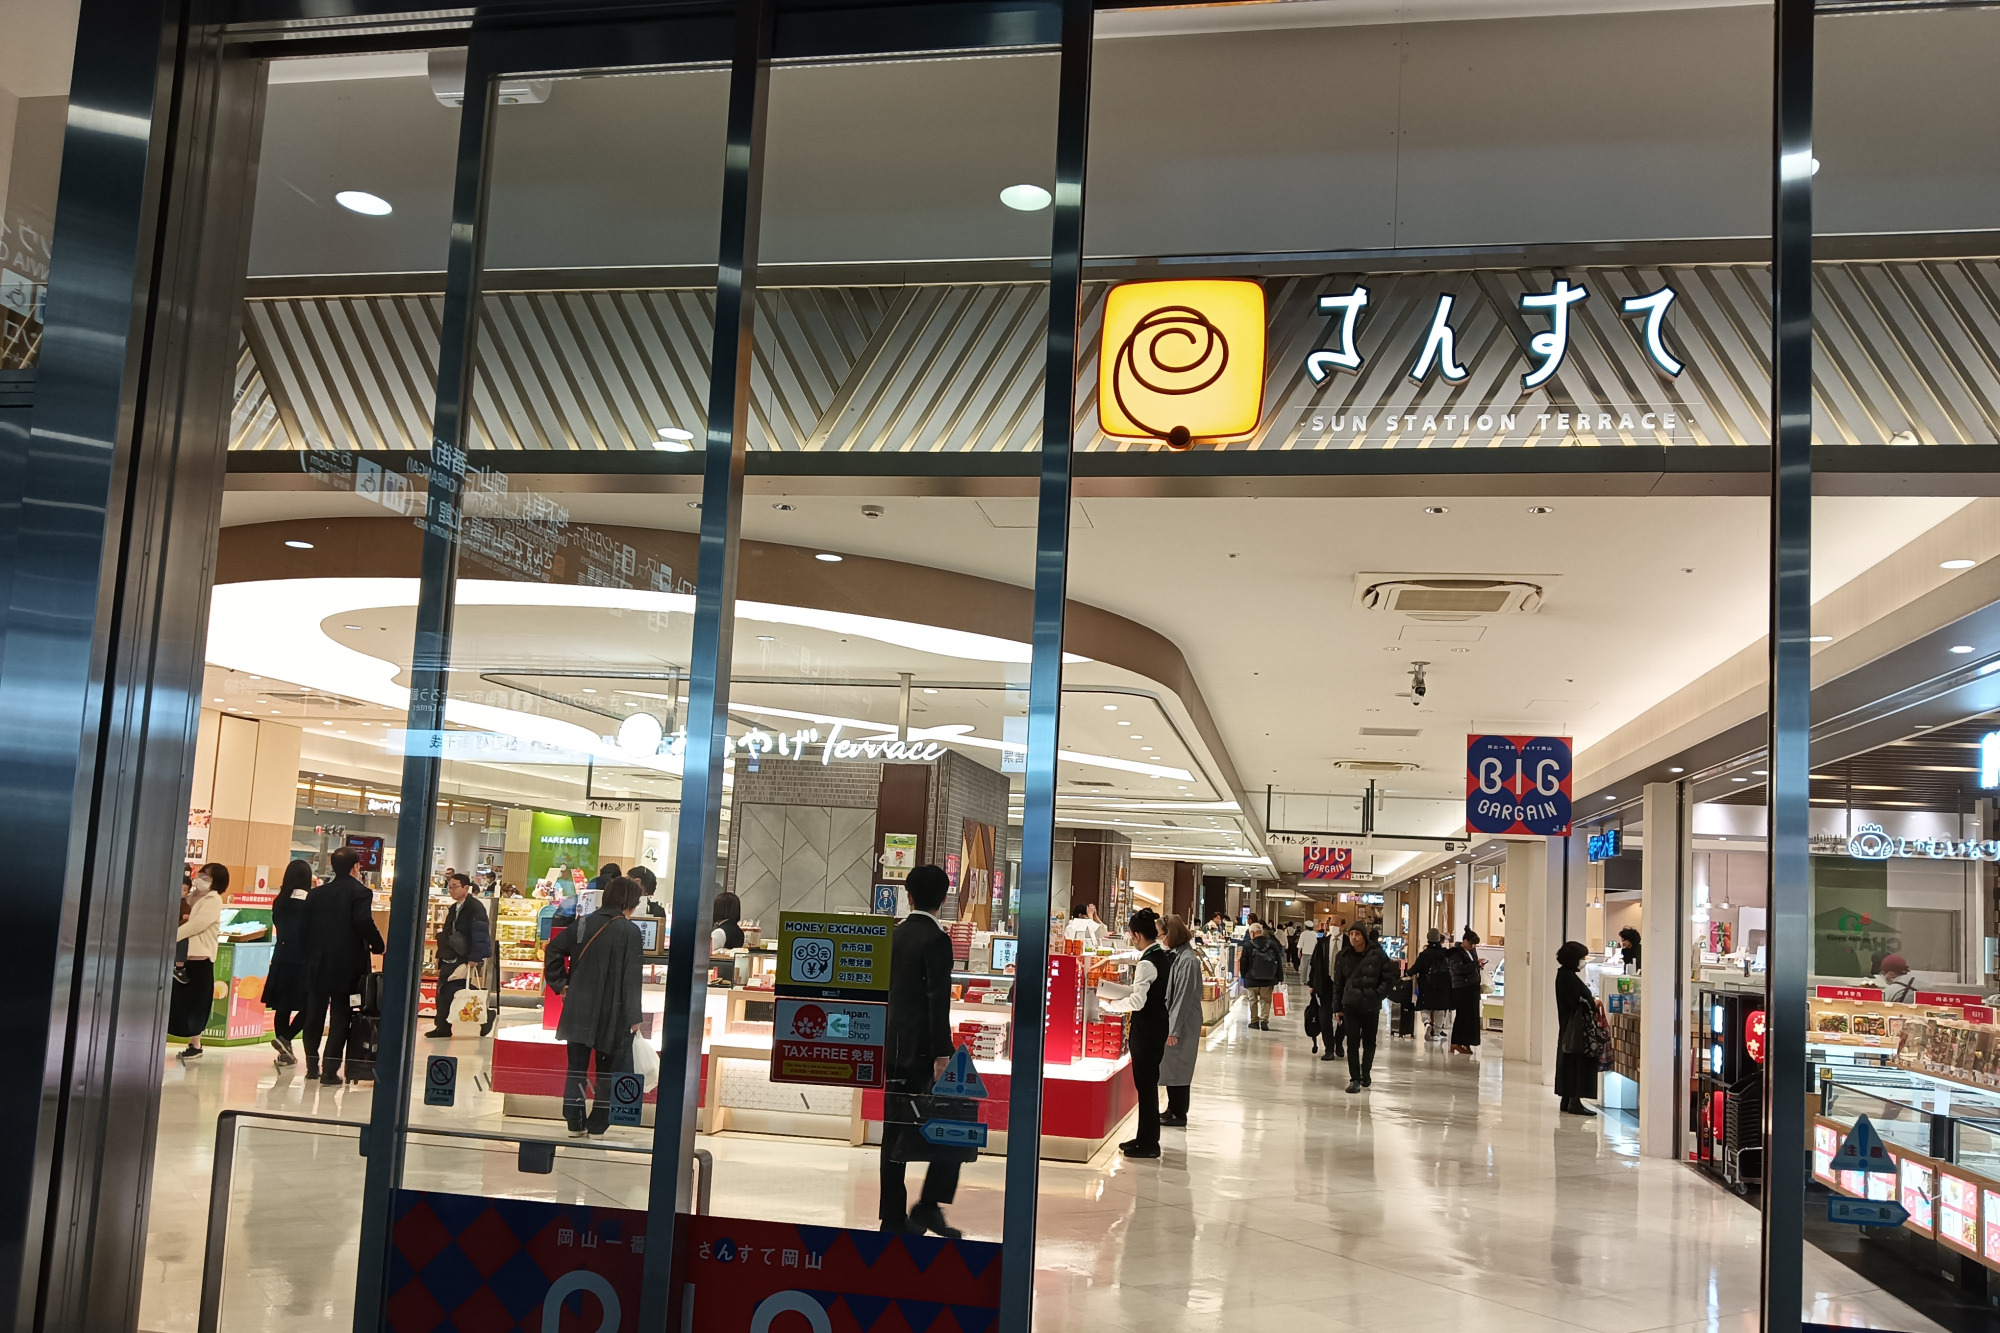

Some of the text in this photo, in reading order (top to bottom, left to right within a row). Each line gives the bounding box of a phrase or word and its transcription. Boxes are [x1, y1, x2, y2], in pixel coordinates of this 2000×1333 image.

[1305, 278, 1686, 394] さんすて
[1311, 412, 1677, 432] SUN STATION TERRACE
[815, 720, 948, 767] Terrace
[1479, 757, 1560, 797] BIG
[1478, 799, 1558, 821] BARGAIN
[541, 835, 589, 845] HAREMASU
[1308, 862, 1345, 874] BARGAIN
[784, 921, 887, 936] MONEY EXCHANGE
[837, 972, 872, 983] 외화환전
[848, 1030, 870, 1041] Shop
[782, 1045, 848, 1061] TAX-FREE
[610, 1106, 640, 1115] ドアに注意
[556, 1227, 823, 1271] 岡山一番 さんすて岡山
